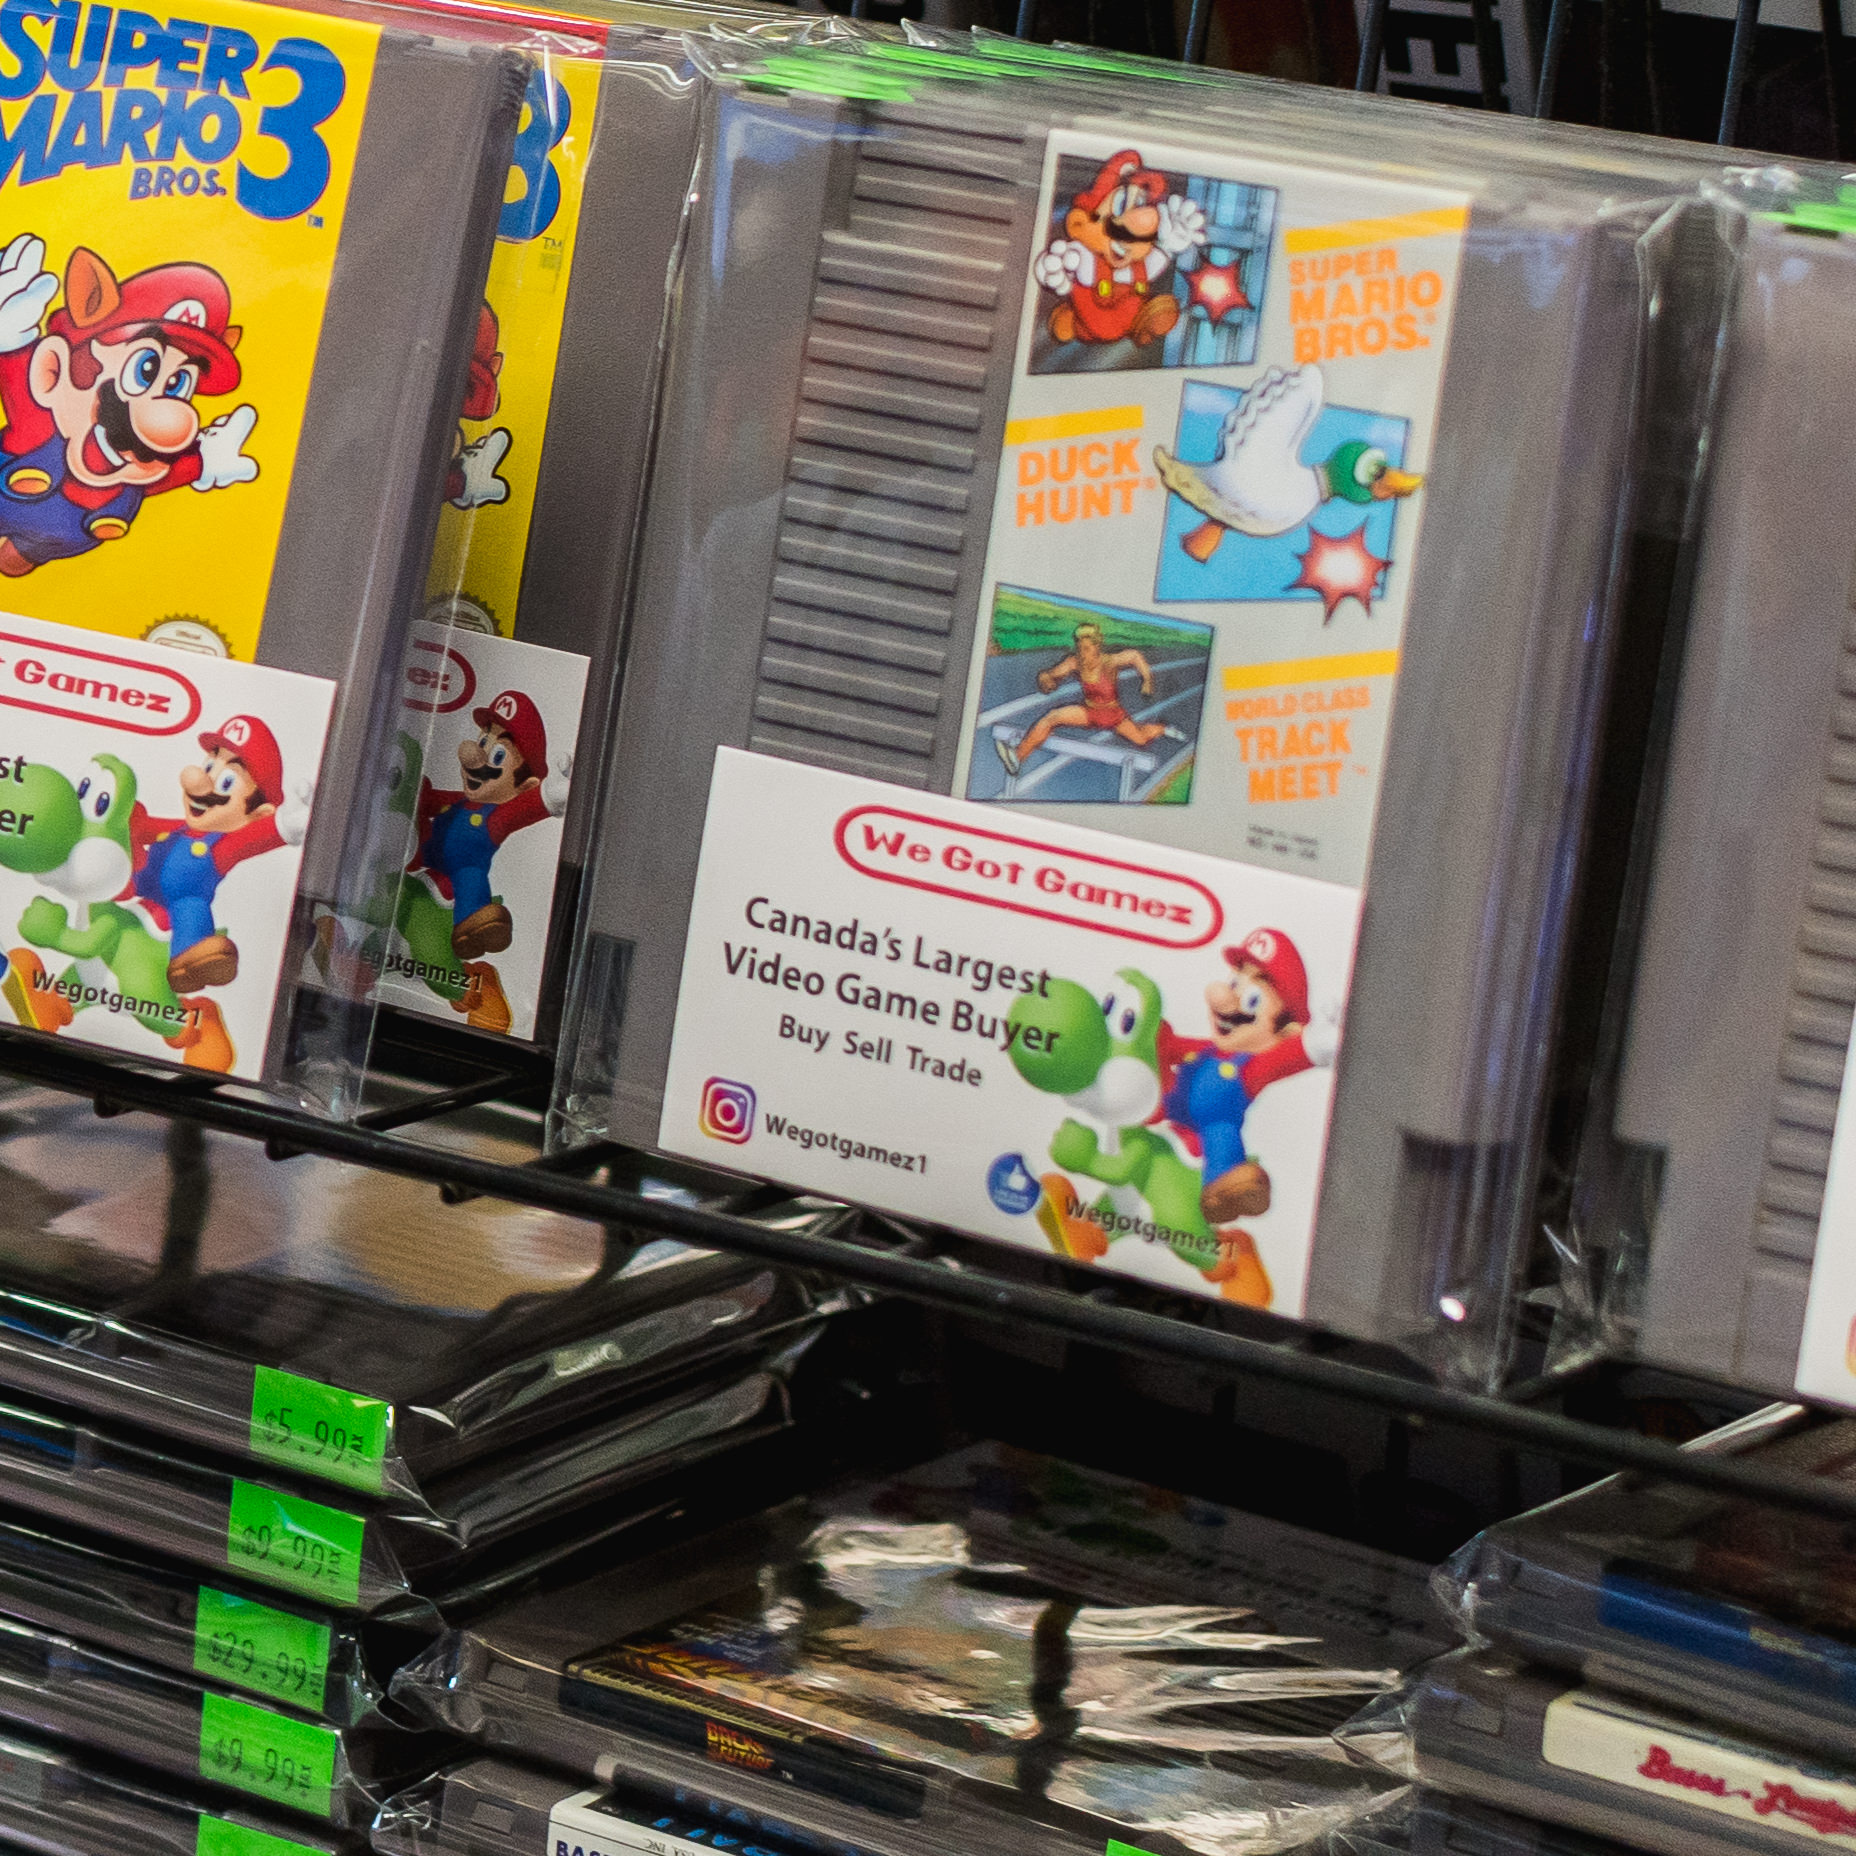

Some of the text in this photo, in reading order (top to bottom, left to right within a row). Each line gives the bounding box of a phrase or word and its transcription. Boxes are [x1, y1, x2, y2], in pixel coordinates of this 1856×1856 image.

[234, 37, 346, 220] 3
[128, 164, 228, 200] BROS.
[1289, 248, 1399, 287] SUPER
[1289, 271, 1443, 326] MARIO
[1292, 314, 1430, 365] BROS.
[1017, 437, 1142, 488] DUCK
[1015, 478, 1139, 528] HUNT
[13, 657, 173, 716] Gamez
[1224, 691, 1298, 725] WORLD
[1236, 718, 1352, 763] TRACK
[1247, 762, 1344, 805] MEET
[862, 823, 1194, 926] We Got Gamez
[744, 896, 1053, 999] Canada's Largest
[30, 969, 204, 1029] Wegotgamez1
[723, 942, 1061, 1056] Video Game Buyer
[778, 1013, 983, 1087] Buy Sell Trade
[764, 1111, 930, 1175] Wegotgamez1
[1063, 1194, 1239, 1258] Wegotgamez1
[264, 1407, 347, 1463] $5.99
